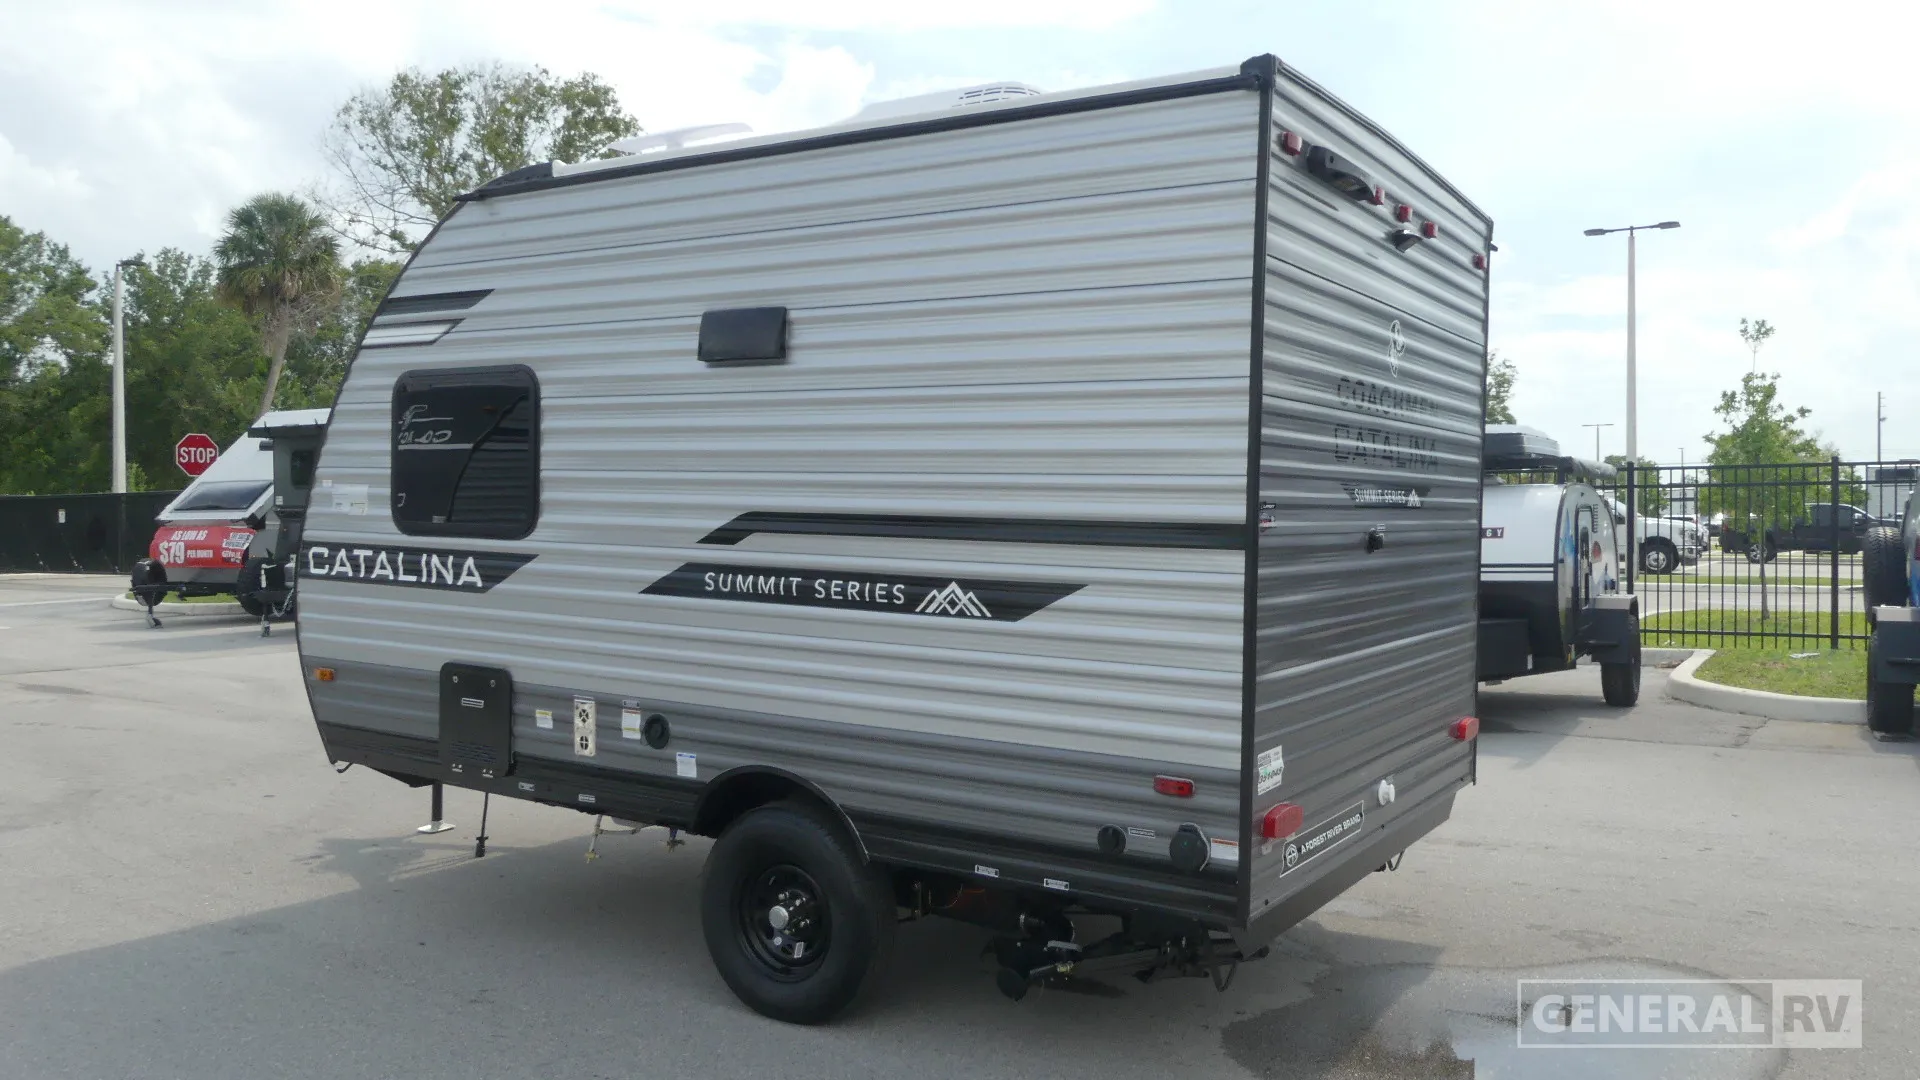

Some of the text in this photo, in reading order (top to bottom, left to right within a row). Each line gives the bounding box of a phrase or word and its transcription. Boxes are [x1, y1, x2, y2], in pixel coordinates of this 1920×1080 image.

[180, 447, 216, 463] STOP
[1354, 488, 1406, 503] SUMMIT SERIES
[171, 530, 208, 540] AS LOW AS
[158, 540, 185, 565] $79
[186, 549, 197, 558] PER
[197, 549, 213, 558] MONTH
[308, 547, 483, 587] CATALINA
[704, 572, 906, 605] SUMMIT SERIES
[1301, 813, 1361, 854] A FOREST RIVER BRAND
